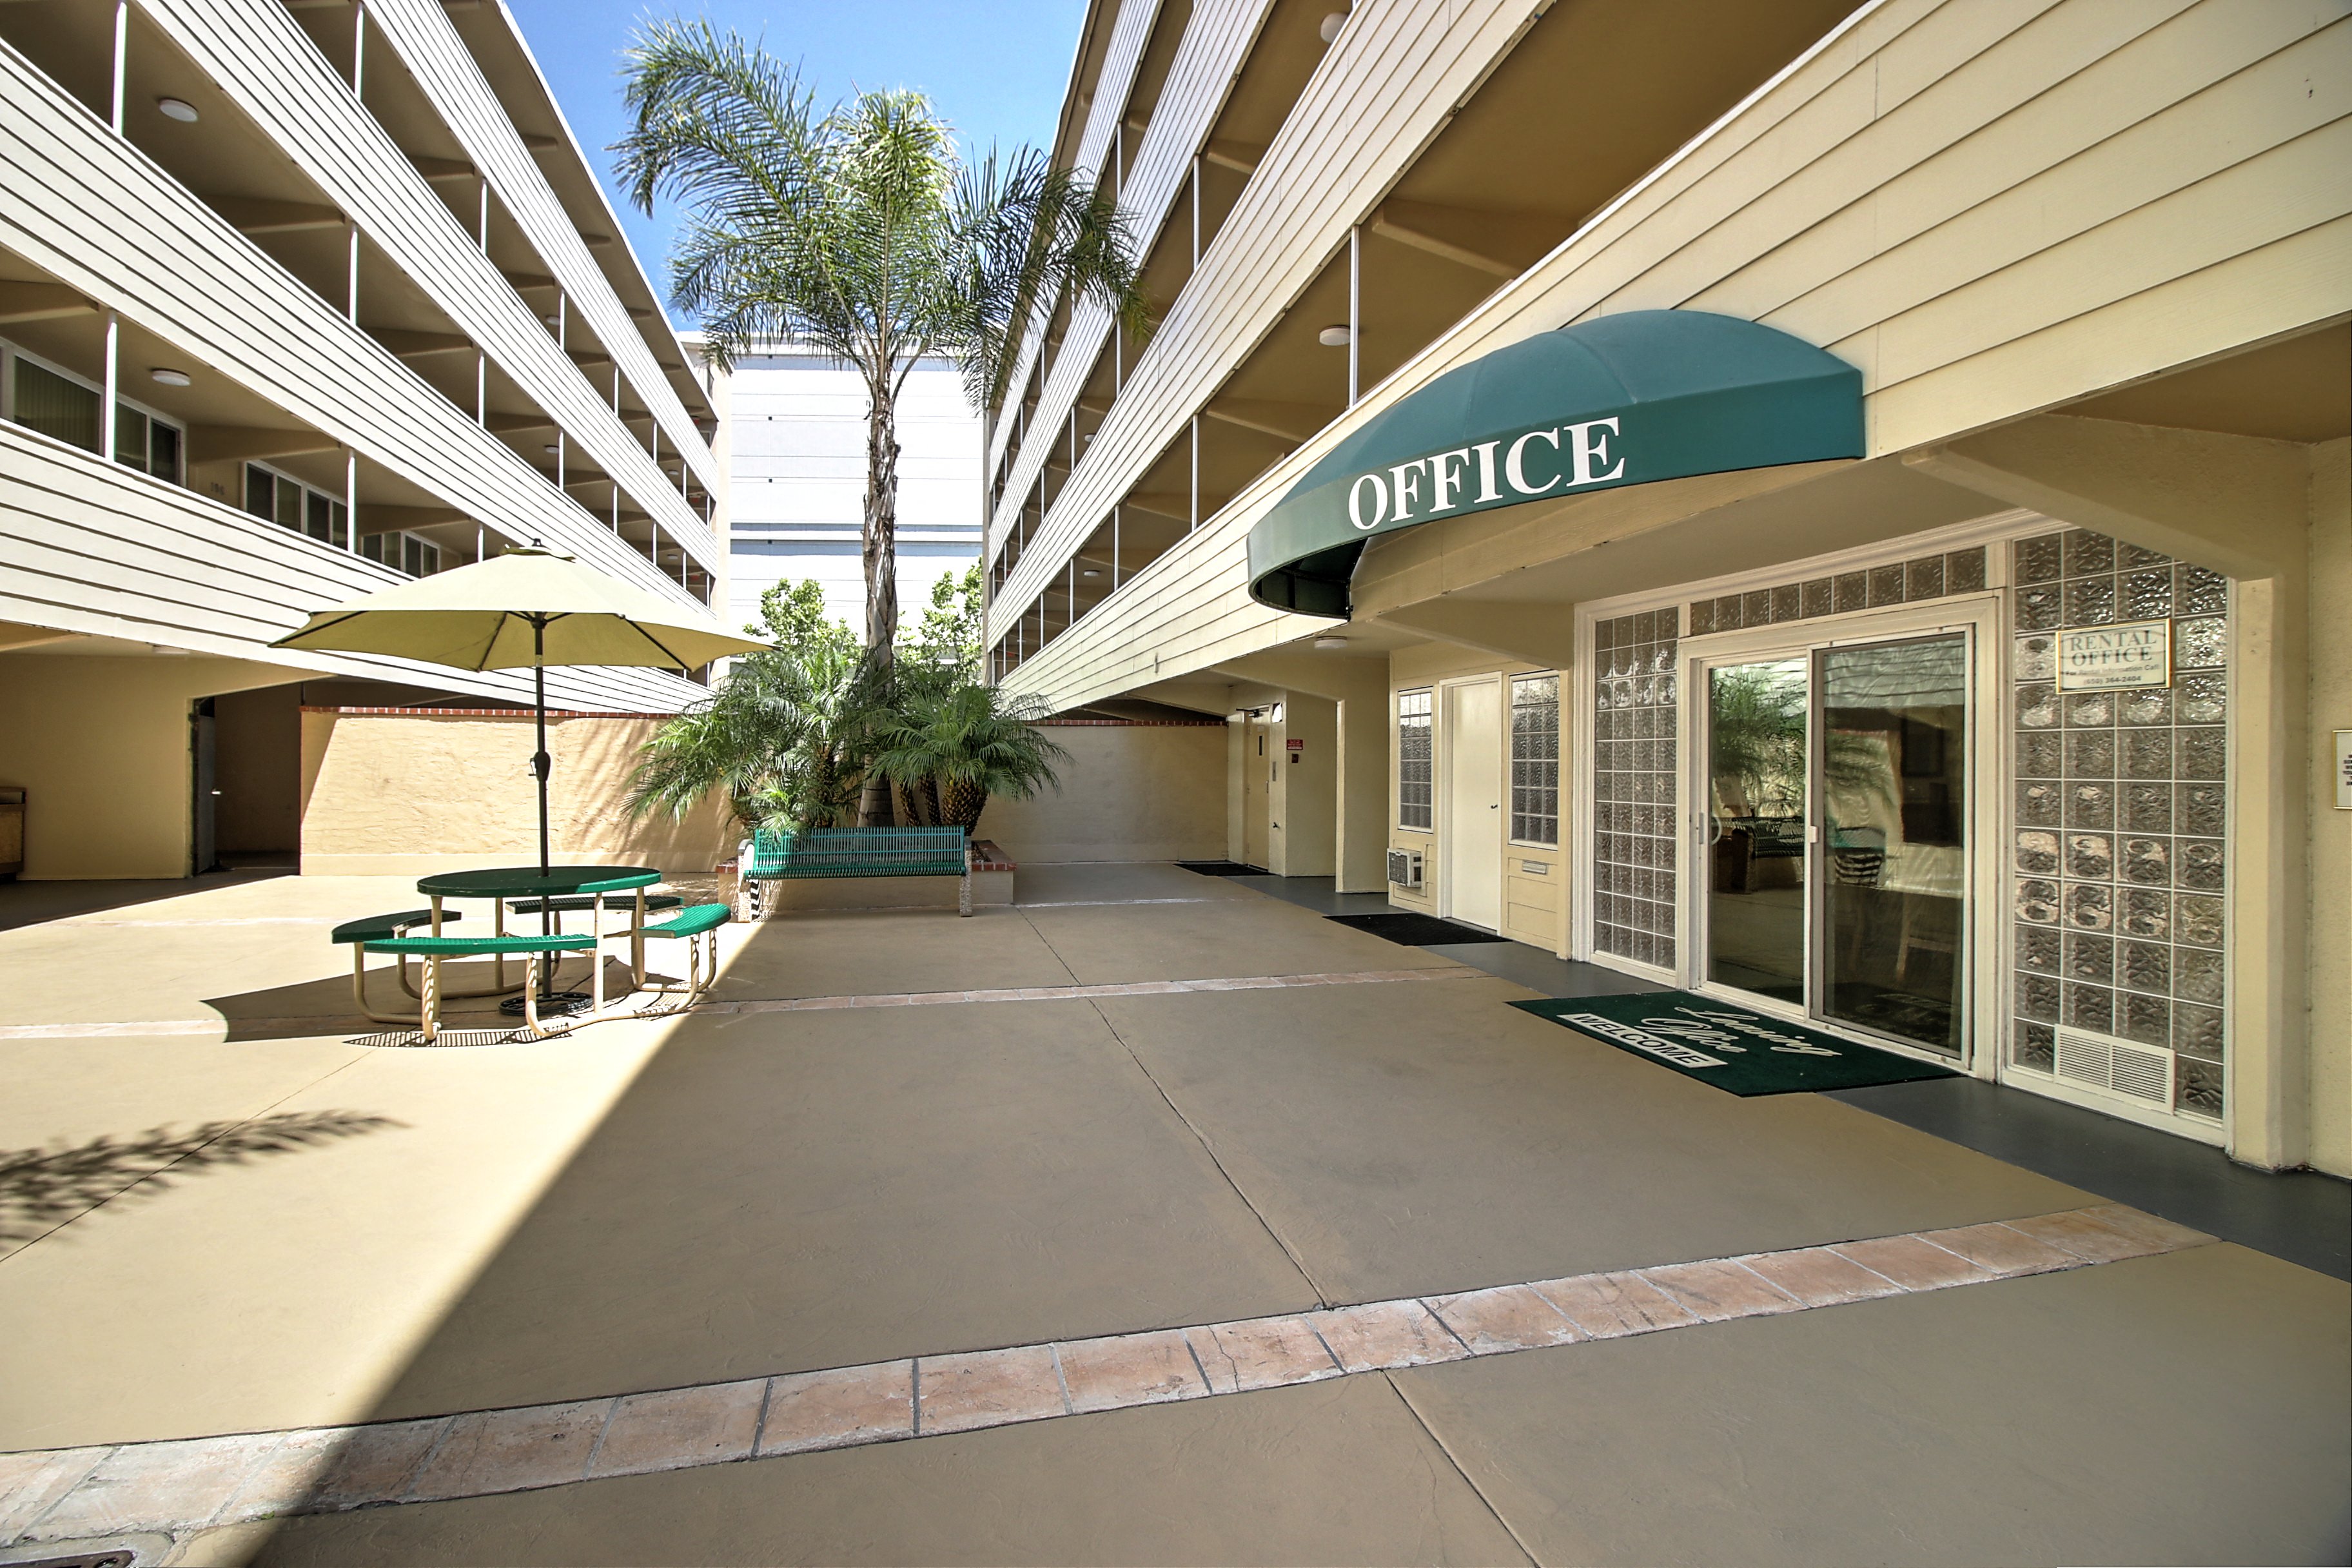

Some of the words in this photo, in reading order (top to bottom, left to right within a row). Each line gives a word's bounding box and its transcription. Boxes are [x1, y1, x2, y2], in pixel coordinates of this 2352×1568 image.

[1348, 416, 1625, 531] OFFICE
[2070, 630, 2156, 651] RENTAL
[2072, 646, 2152, 667] OFFICE
[1573, 1015, 1710, 1064] WELCOME
[1634, 1017, 1748, 1053] Office
[1674, 1006, 1843, 1057] Leasing
